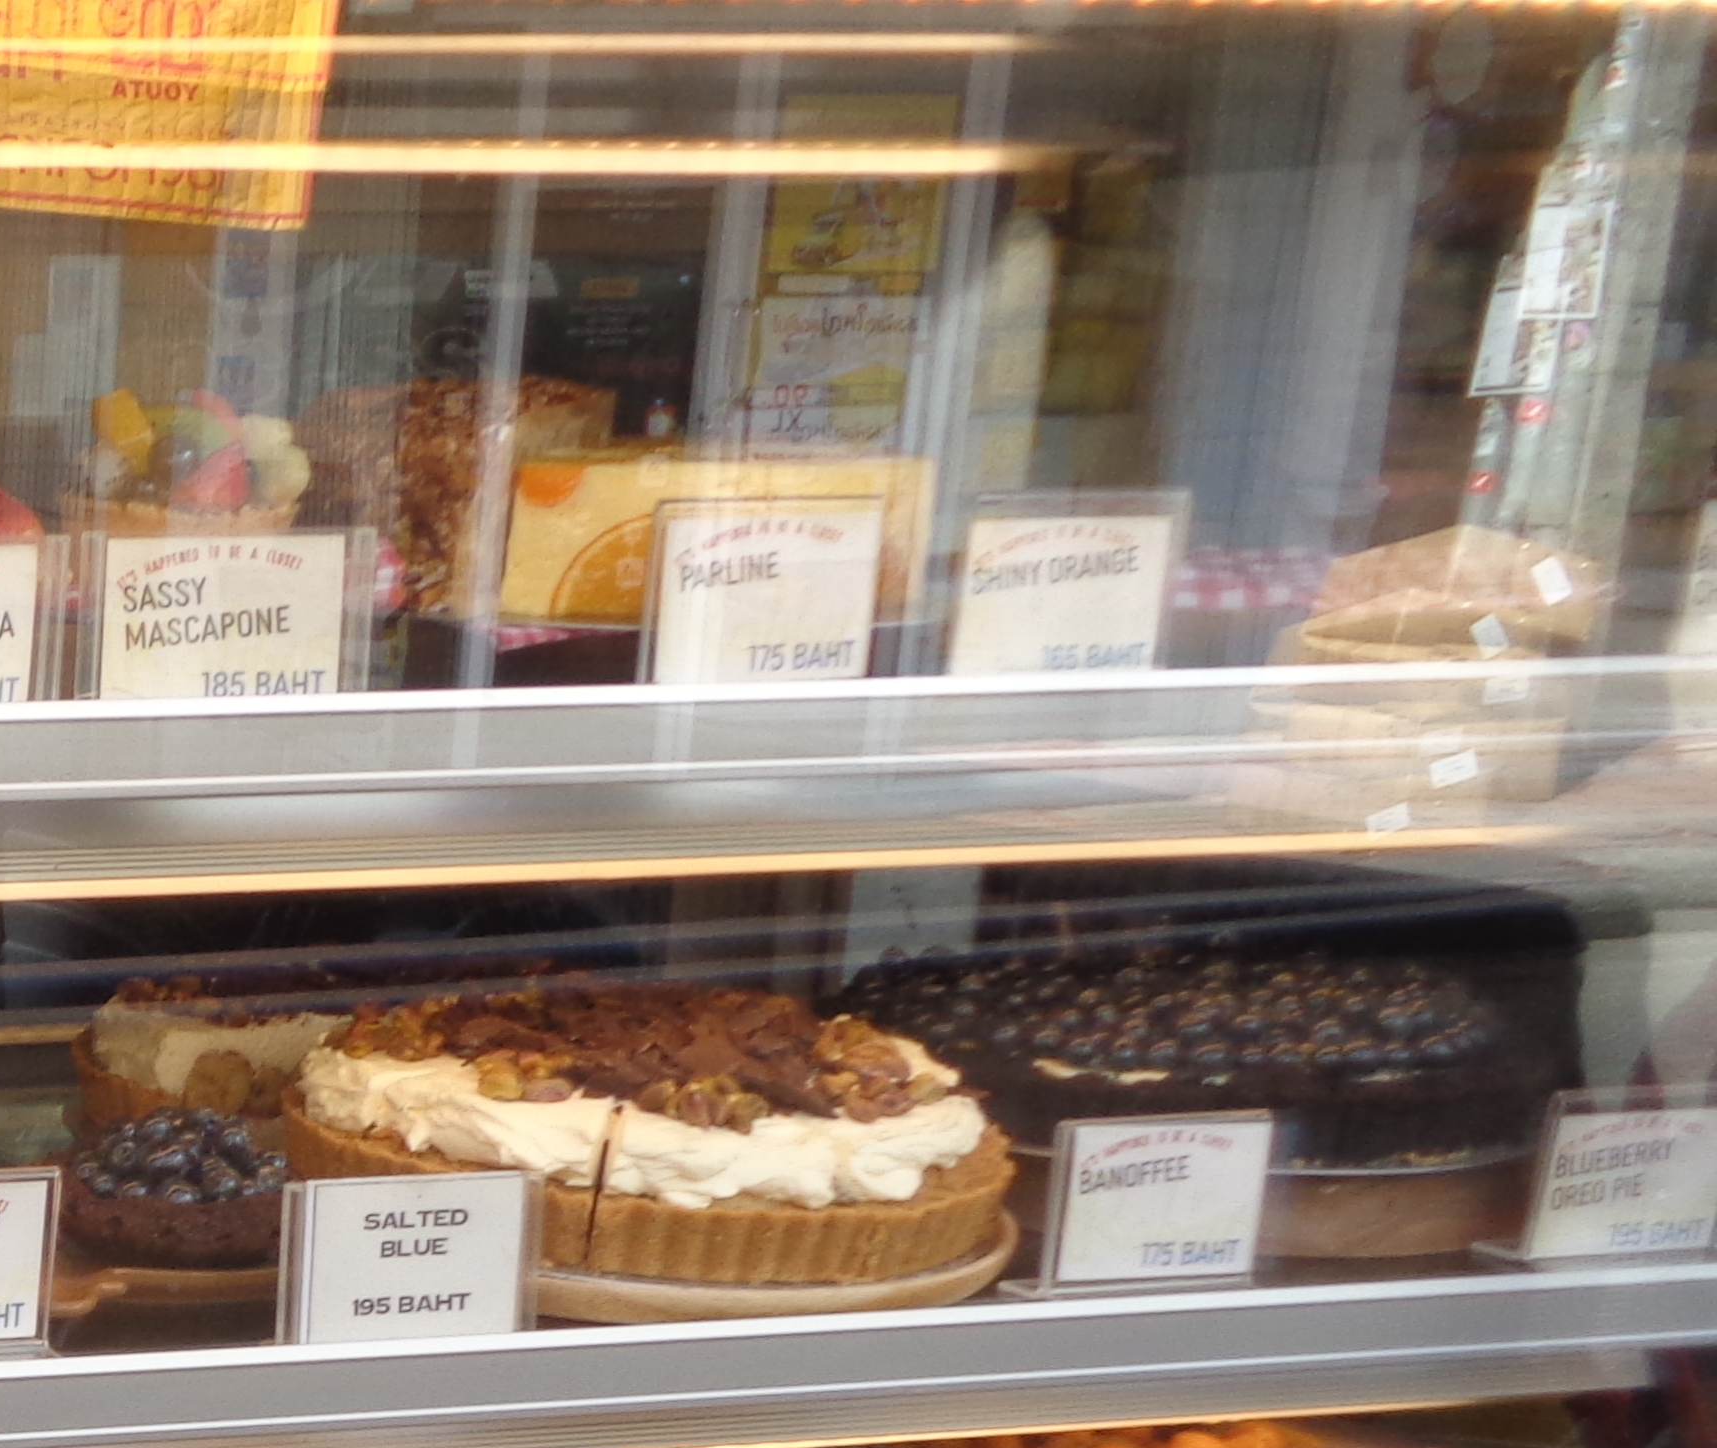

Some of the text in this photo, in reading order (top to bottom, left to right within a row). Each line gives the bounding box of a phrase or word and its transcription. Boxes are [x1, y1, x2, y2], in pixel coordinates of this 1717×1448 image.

[123, 577, 206, 612] SASSY
[126, 605, 290, 650] MASCAPONE
[793, 640, 855, 670] BAHT
[203, 670, 325, 697] 185 BAHT
[1080, 1155, 1190, 1194] BANOFFEE
[364, 1209, 468, 1230] SALTED
[380, 1238, 448, 1258] BLUE
[1181, 1239, 1240, 1265] BAHT
[353, 1293, 471, 1316] 195 BAHT
